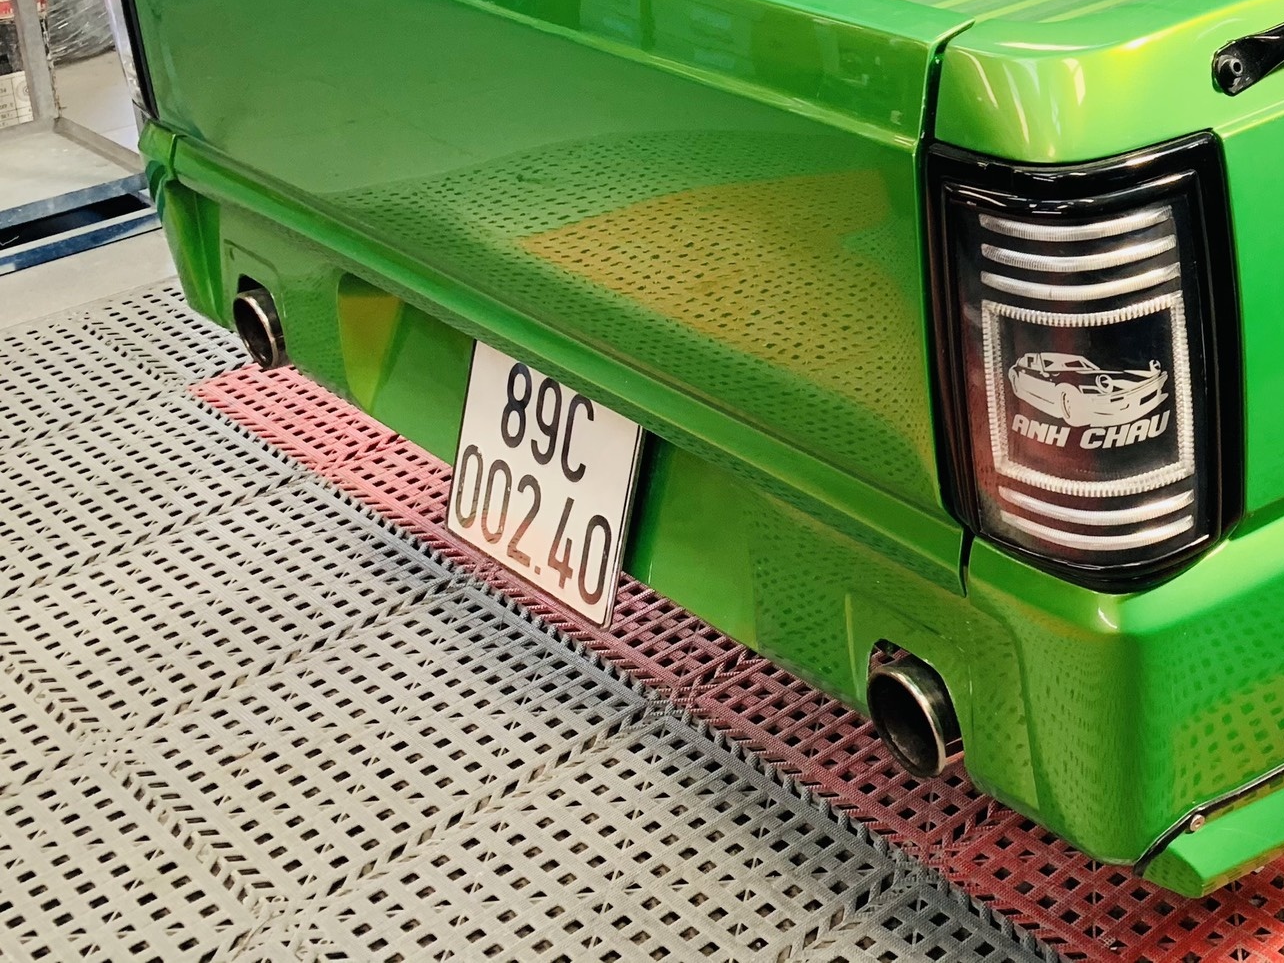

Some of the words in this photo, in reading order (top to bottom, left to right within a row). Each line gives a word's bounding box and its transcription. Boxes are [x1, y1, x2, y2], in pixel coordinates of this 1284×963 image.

[501, 362, 594, 483] 89C
[1011, 414, 1070, 448] ANH
[1079, 410, 1171, 450] CHAU
[456, 444, 612, 605] 002.40
